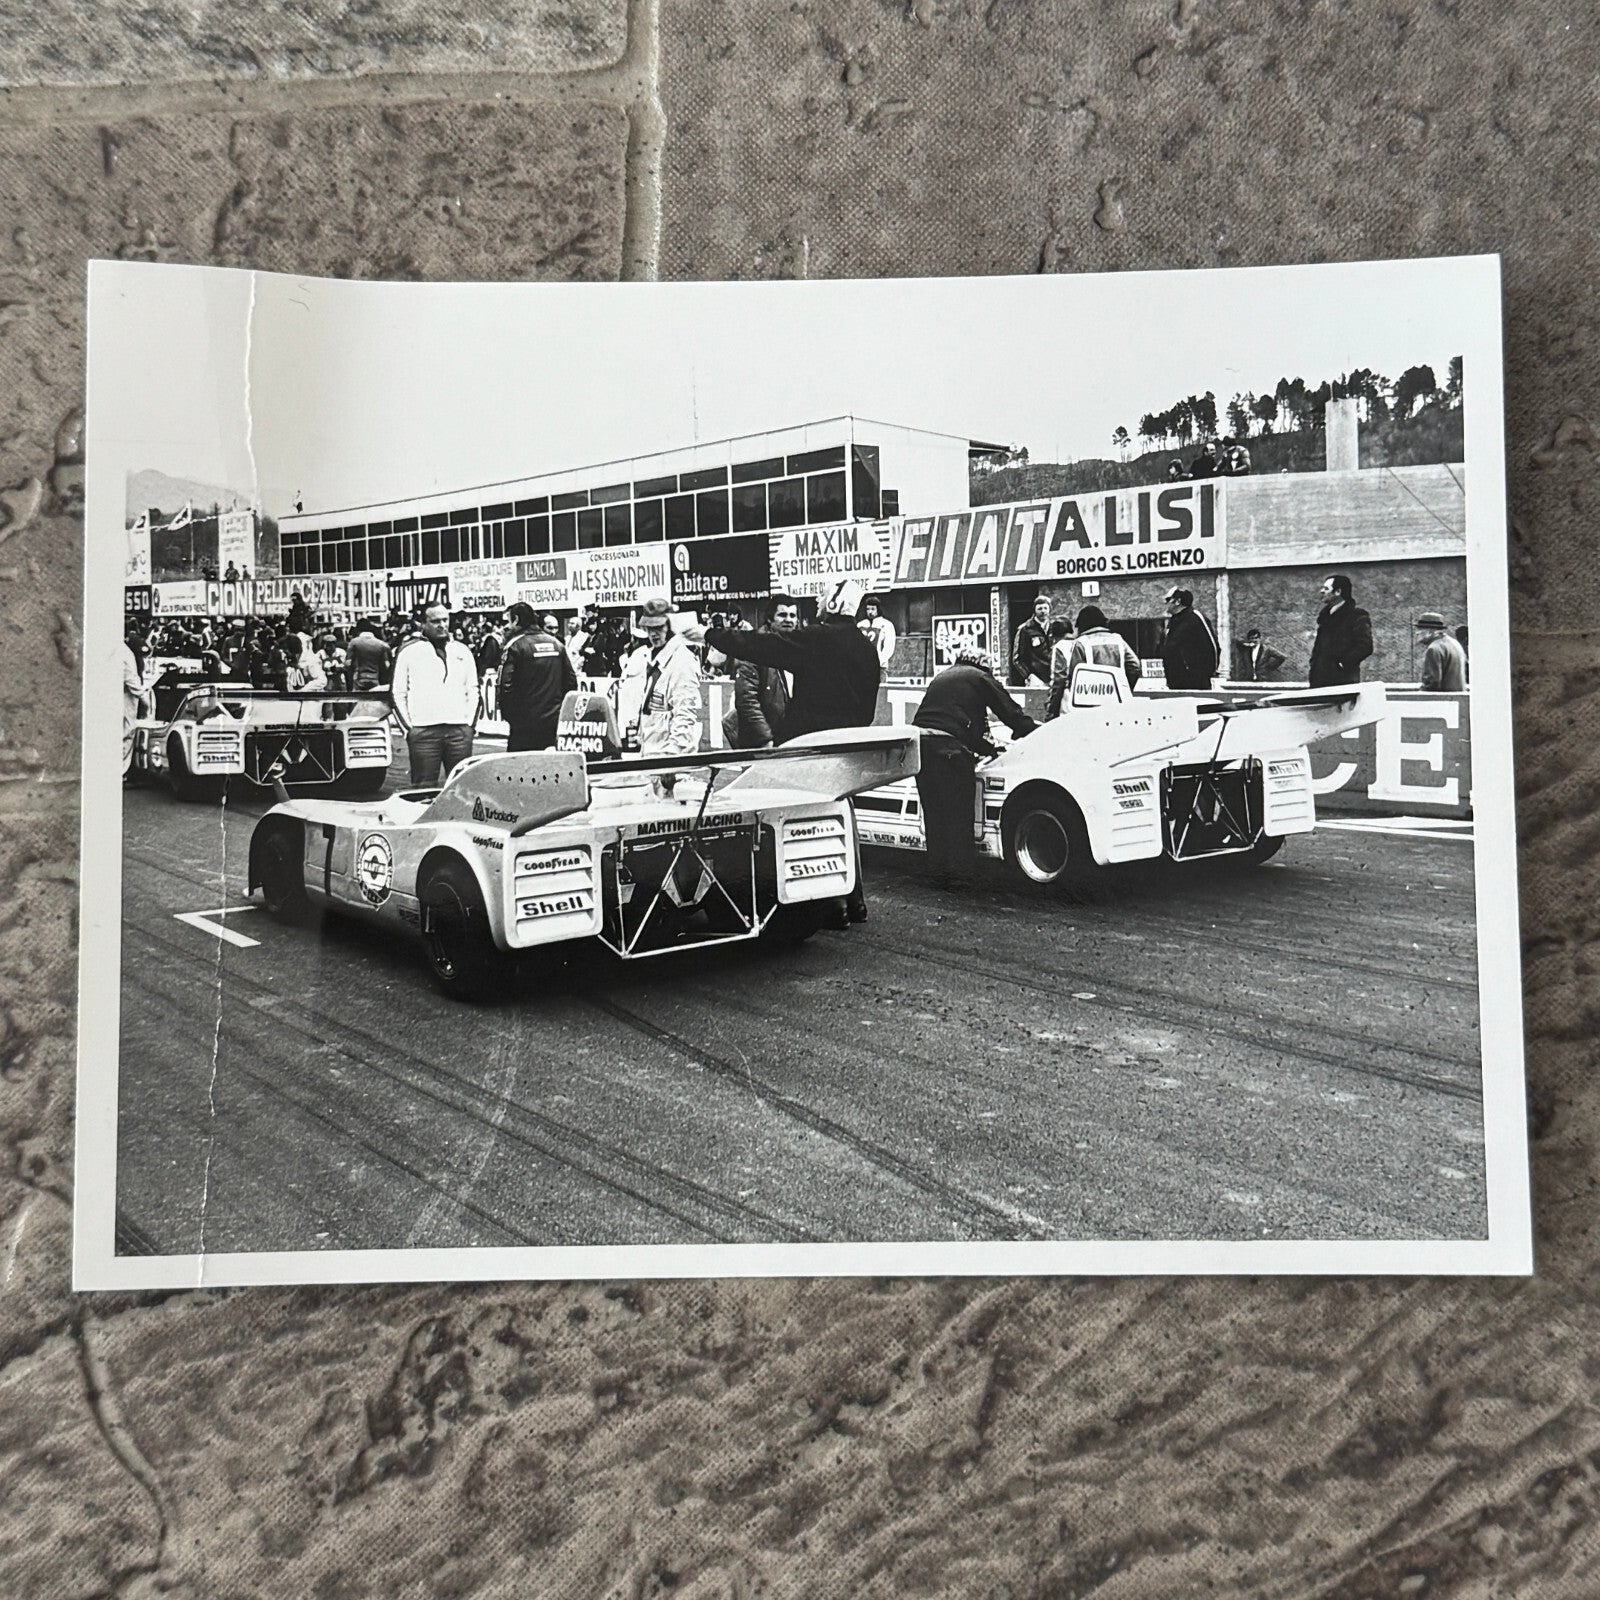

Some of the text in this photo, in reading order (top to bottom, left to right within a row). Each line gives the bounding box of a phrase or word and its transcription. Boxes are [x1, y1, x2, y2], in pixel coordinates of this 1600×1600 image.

[795, 528, 858, 557] MAXIM
[897, 509, 1047, 580] FIAT
[590, 550, 640, 562] CONCESSIONARIA
[1057, 548, 1205, 575] BORGO S. LORENZO
[525, 561, 556, 581] LANCIA
[572, 563, 665, 591] ALESSANDRINI
[675, 573, 728, 593] abitare
[126, 591, 149, 611] SSO
[207, 582, 253, 616] CIONI
[463, 595, 506, 609] SCARPERIA
[518, 588, 568, 603] AUTOBIANCHI
[595, 590, 638, 603] FIRENZE
[936, 619, 985, 636] AUTO
[559, 721, 608, 737] MARTINI
[557, 738, 604, 753] RACING
[1113, 781, 1150, 796] Shell
[637, 818, 691, 836] MARTINI
[524, 857, 581, 871] GOODYEAR
[790, 860, 838, 876] Shell
[522, 895, 583, 916] Shell
